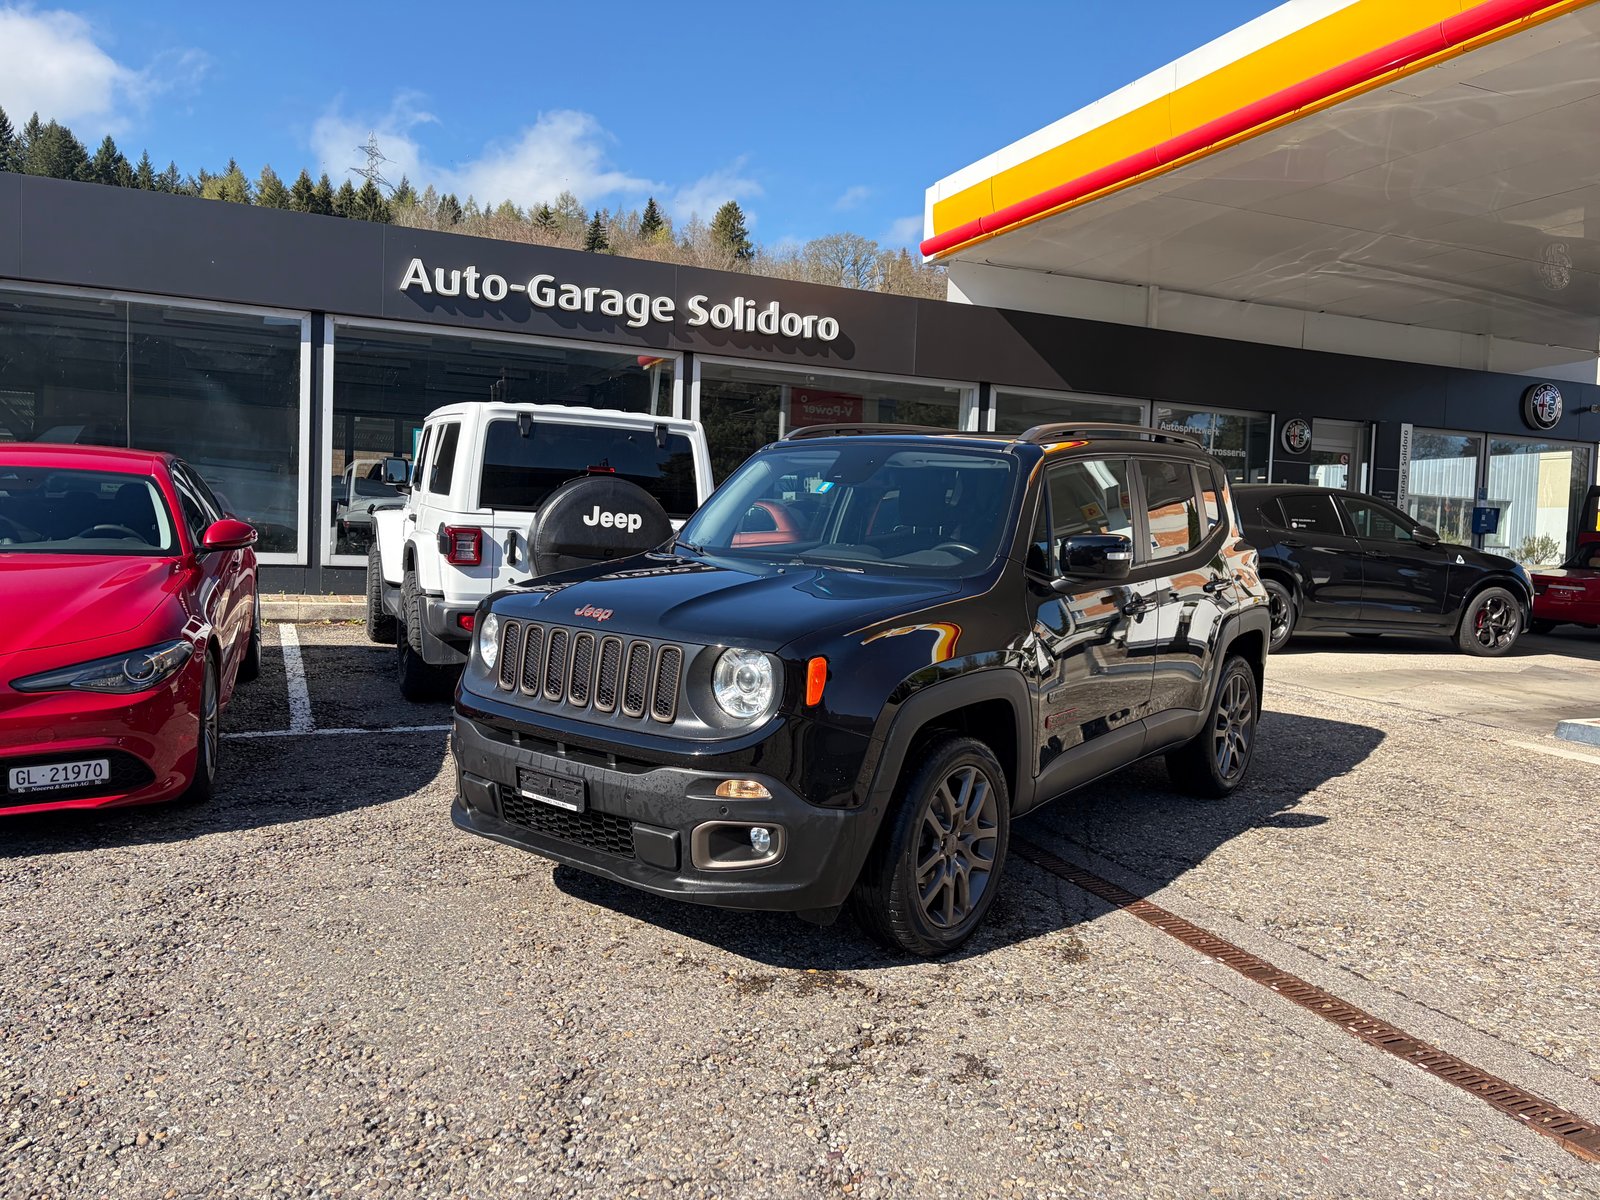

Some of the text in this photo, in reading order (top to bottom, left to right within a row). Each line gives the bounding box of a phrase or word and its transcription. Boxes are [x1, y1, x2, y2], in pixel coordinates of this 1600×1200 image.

[399, 257, 841, 342] Auto-Garage Solidoro
[1399, 429, 1409, 510] o-Garage Solidoro
[583, 505, 642, 533] Jeep
[574, 603, 614, 622] Jeep
[15, 762, 103, 786] GL 21970
